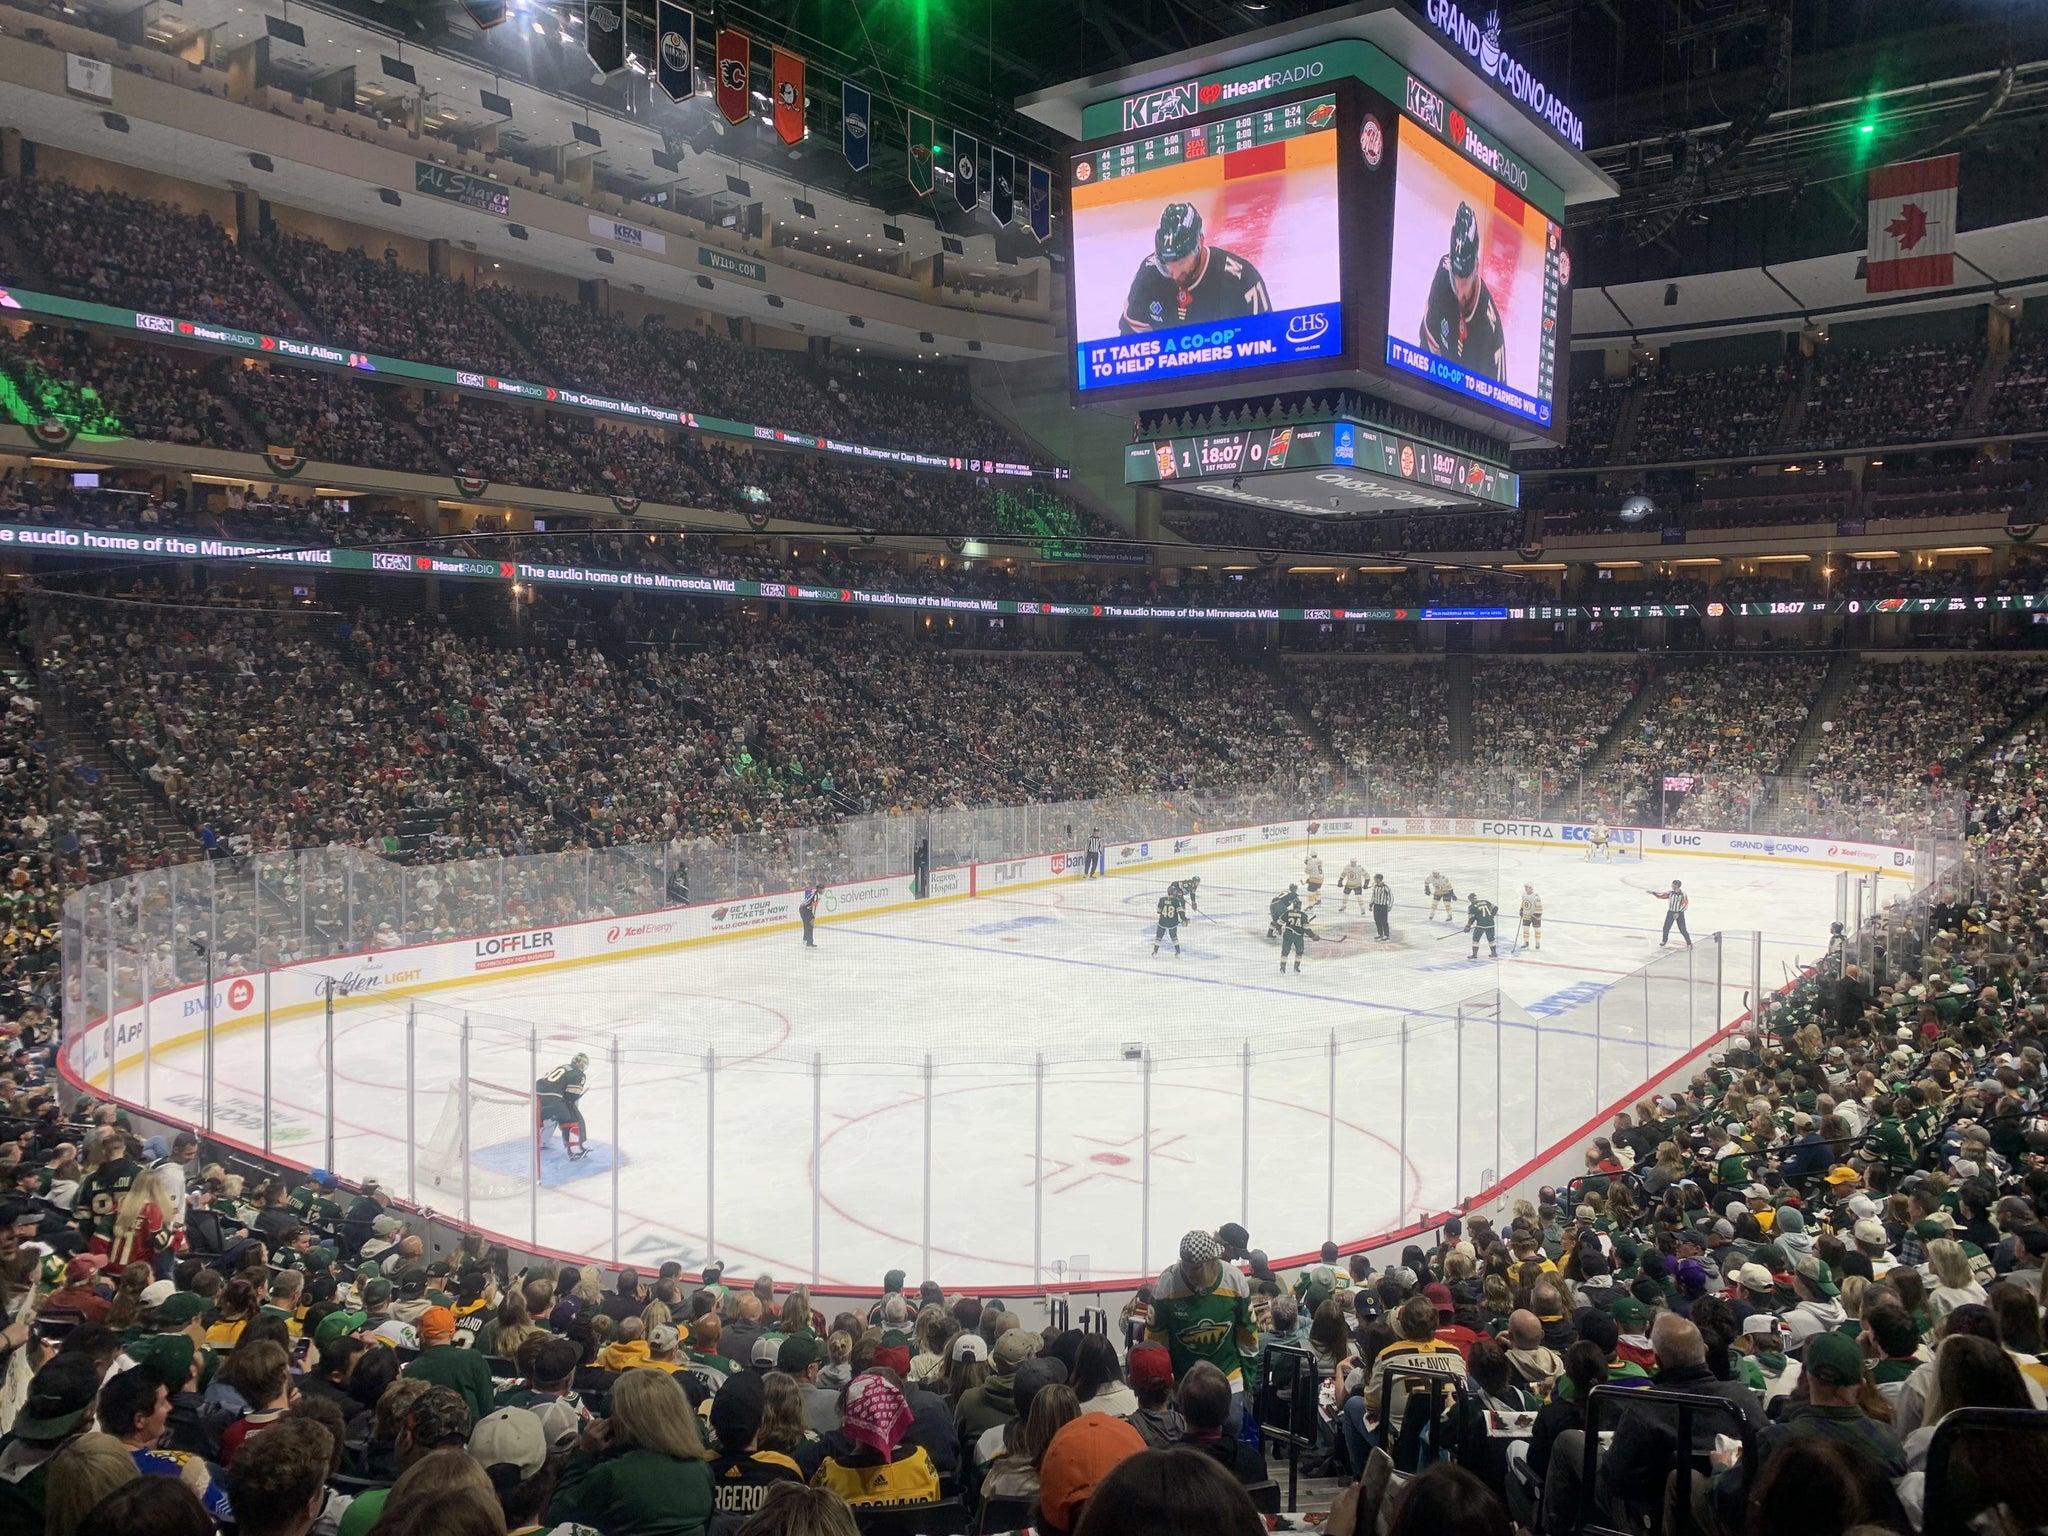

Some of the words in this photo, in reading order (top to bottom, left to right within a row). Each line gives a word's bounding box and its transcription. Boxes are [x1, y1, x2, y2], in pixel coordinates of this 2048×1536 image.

[1427, 0, 1480, 56] GRAND
[1498, 52, 1545, 113] CASINO
[1544, 94, 1584, 151] ARENA
[1123, 82, 1199, 132] KFAN
[1222, 61, 1324, 100] iHeartRADIO
[1263, 113, 1273, 123] 38
[1285, 106, 1301, 118] 0:24
[1216, 124, 1224, 133] 17
[1236, 117, 1251, 129] 0:00
[1263, 124, 1274, 133] 24
[1285, 117, 1301, 129] 0:14
[1186, 138, 1205, 149] SEAT
[1102, 151, 1110, 160] 44
[1120, 146, 1134, 157] 0:00
[1186, 147, 1206, 159] GEEK
[1102, 173, 1111, 182] 52
[1121, 167, 1135, 178] 0:24
[417, 170, 442, 187] Al
[445, 175, 509, 206] Shaver
[460, 195, 487, 210] PRESS
[488, 202, 508, 215] BOX
[614, 223, 642, 242] KFAN
[1289, 313, 1326, 335] CHS
[136, 312, 174, 333] KFAN
[279, 339, 309, 357] Paul
[311, 346, 343, 362] Allen
[1091, 348, 1107, 364] IT
[1109, 340, 1161, 361] TAKES
[1164, 339, 1176, 353] A
[1092, 362, 1113, 378] TO
[1116, 356, 1154, 375] HELP
[1158, 345, 1233, 369] FARMERS
[1236, 339, 1277, 357] WIN.
[1393, 344, 1402, 359] IT
[1402, 348, 1429, 371] TAKES
[1429, 360, 1436, 375] A
[1465, 375, 1475, 390] TO
[1475, 380, 1492, 396] HELP
[1493, 386, 1523, 410] FARMERS
[456, 371, 484, 389] KFAN
[559, 390, 578, 404] The
[580, 395, 619, 411] Common
[620, 401, 641, 413] Man
[1203, 439, 1209, 448] 2
[1213, 437, 1230, 445] SHOTS
[1234, 436, 1240, 444] 0
[1297, 431, 1321, 439] PENALTY
[754, 426, 774, 440] KFAN
[827, 440, 853, 455] Bumper
[854, 444, 862, 455] to
[863, 446, 890, 460] Bumper
[900, 450, 915, 462] Dan
[1130, 449, 1150, 457] PENALTY
[1182, 452, 1191, 468] 1
[1201, 445, 1243, 464] 18:07
[1251, 444, 1262, 461] 0
[1388, 455, 1393, 466] 2
[1216, 463, 1237, 471] PERIOD
[1420, 454, 1426, 473] 1
[1433, 453, 1455, 474] 18:07
[1458, 465, 1465, 484] 0
[18, 527, 79, 547] audio
[83, 532, 139, 552] home
[143, 535, 165, 553] of
[166, 537, 197, 555] the
[201, 540, 294, 563] Minnesota
[297, 548, 331, 564] Wild
[373, 553, 411, 571] KFAN
[432, 560, 494, 575] iHeartRADIO
[518, 564, 544, 579] The
[547, 566, 584, 581] audio
[585, 567, 617, 583] home
[620, 569, 632, 584] of
[633, 570, 652, 586] the
[654, 574, 711, 590] Minnesota
[713, 579, 736, 593] Wild
[760, 583, 785, 598] KFAN
[853, 591, 870, 603] The
[871, 592, 894, 605] audio
[895, 593, 917, 606] home
[918, 594, 927, 606] of
[927, 595, 940, 607] the
[940, 596, 979, 609] Minnesota
[980, 598, 998, 610] Wild
[1017, 602, 1039, 614] KFAN
[1104, 606, 1123, 616] The
[1124, 606, 1149, 617] audio
[1150, 607, 1175, 617] home
[1176, 607, 1187, 617] of
[1188, 607, 1204, 618] the
[1206, 608, 1256, 619] Minnesota
[1258, 609, 1279, 619] Wild
[1509, 609, 1524, 619] TOI
[1740, 603, 1748, 615] 1
[1770, 602, 1805, 614] 18:07
[1848, 600, 1860, 613] 0
[1483, 822, 1554, 838] FORTRA
[1561, 826, 1635, 844] ECAB
[1674, 834, 1701, 846] UHC
[1730, 840, 1763, 851] GRAND
[1776, 843, 1809, 854] CASINO
[1066, 854, 1084, 868] ban
[930, 873, 957, 887] Regions
[840, 886, 889, 904] solventum
[930, 881, 959, 897] Hospital
[730, 905, 747, 914] GET
[749, 901, 771, 911] YOUR
[730, 909, 766, 921] TICKETS
[767, 905, 789, 915] NOW!
[1161, 905, 1175, 918] 48
[1478, 904, 1491, 917] 71
[1287, 917, 1302, 928] 24
[475, 931, 554, 958] LOFFLER
[477, 957, 515, 970] TECHNOLOGY
[314, 970, 383, 997] Glden
[384, 968, 422, 985] LIGHT
[714, 1485, 769, 1512] RGERO
